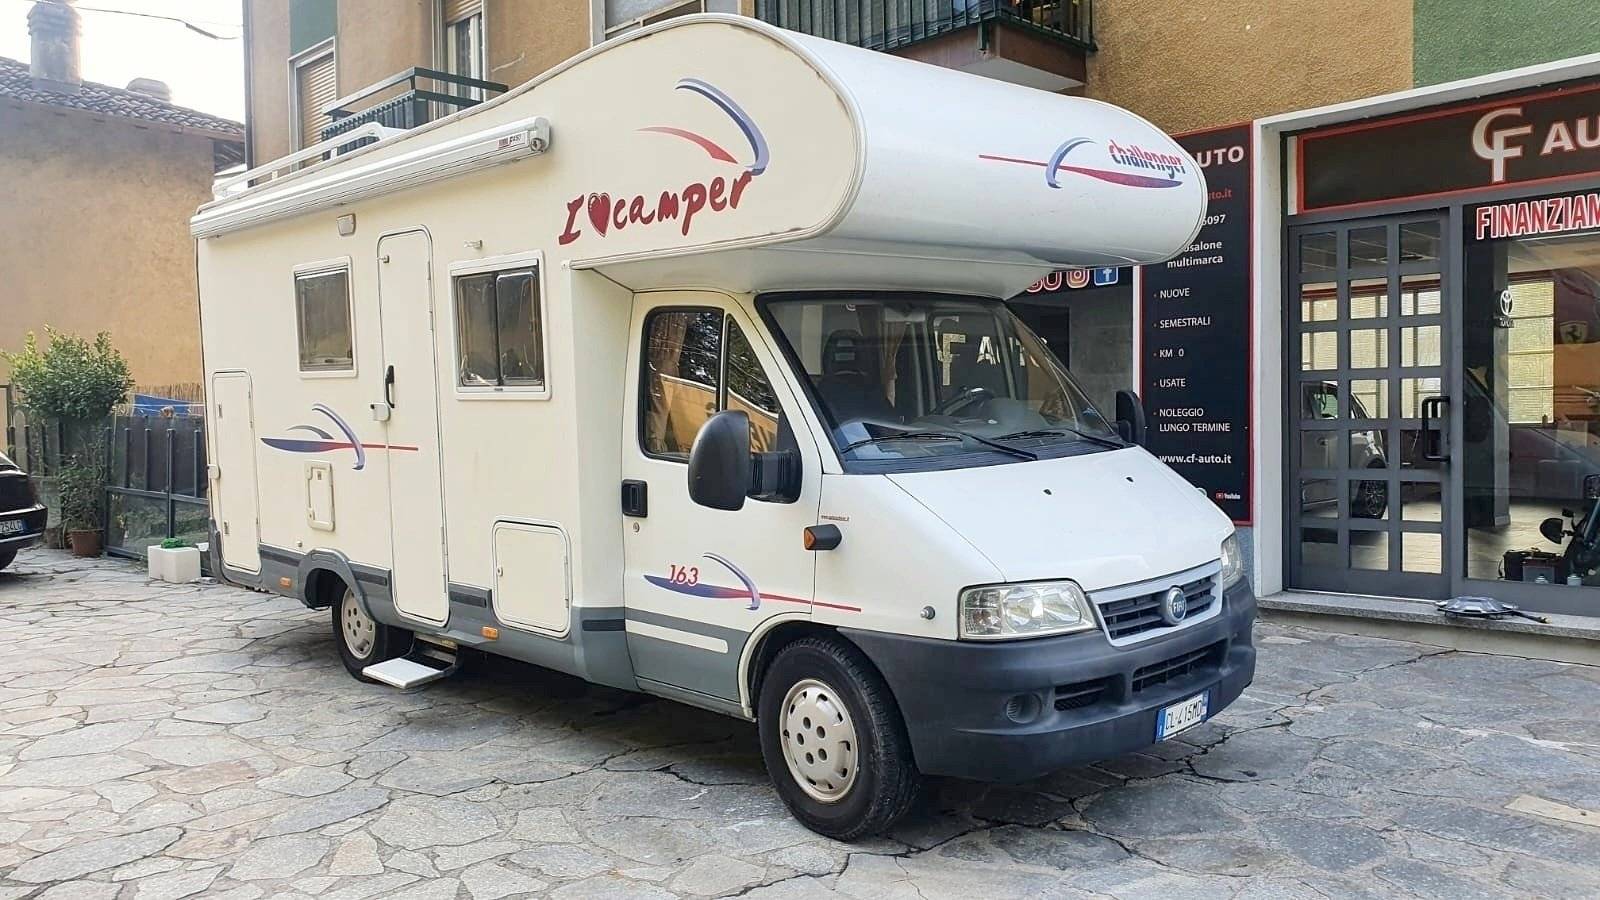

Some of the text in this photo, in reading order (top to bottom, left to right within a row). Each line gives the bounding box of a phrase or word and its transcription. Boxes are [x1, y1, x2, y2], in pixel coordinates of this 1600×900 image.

[1195, 145, 1244, 168] UTO
[612, 170, 753, 236] camper
[1201, 214, 1227, 226] 6097
[1184, 240, 1223, 252] osalone
[1167, 255, 1224, 269] multimarca
[1159, 287, 1191, 300] NUOVE
[1159, 316, 1212, 329] SEMESTRALI
[1159, 348, 1185, 358] KM 0
[1159, 378, 1186, 388] USATE
[1159, 408, 1204, 417] NOLEGGIO
[1159, 422, 1231, 432] LUNGO TERMINE
[1159, 453, 1232, 464] www.cf-auto.it
[668, 564, 699, 585] 163
